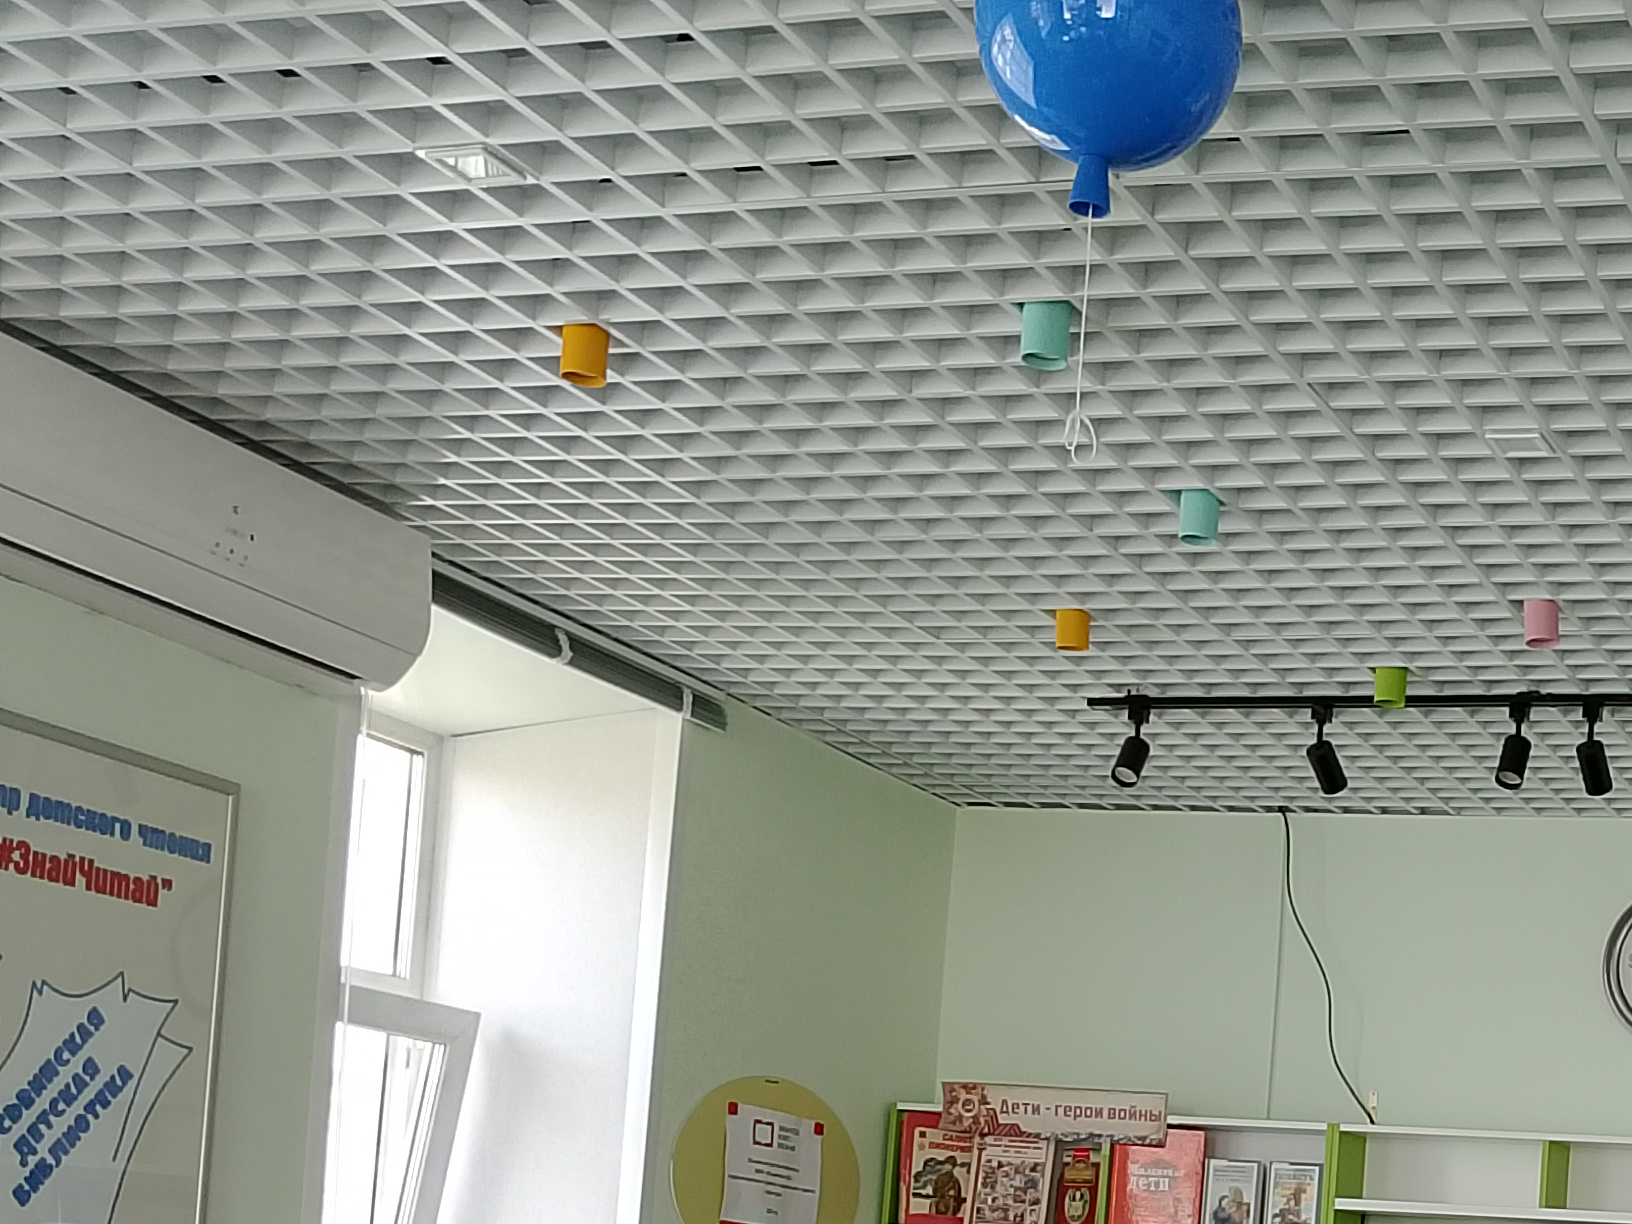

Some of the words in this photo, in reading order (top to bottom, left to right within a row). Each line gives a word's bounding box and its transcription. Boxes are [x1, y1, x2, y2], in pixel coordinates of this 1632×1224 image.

[26, 792, 132, 841] детского
[138, 823, 213, 864] чтения
[12, 1064, 134, 1207] БИБЛИОТЕКА
[13, 1055, 100, 1168] ДЕТСКАЯ
[1000, 1099, 1041, 1116] Дети
[1054, 1104, 1104, 1121] герои
[1107, 1105, 1163, 1123] войны
